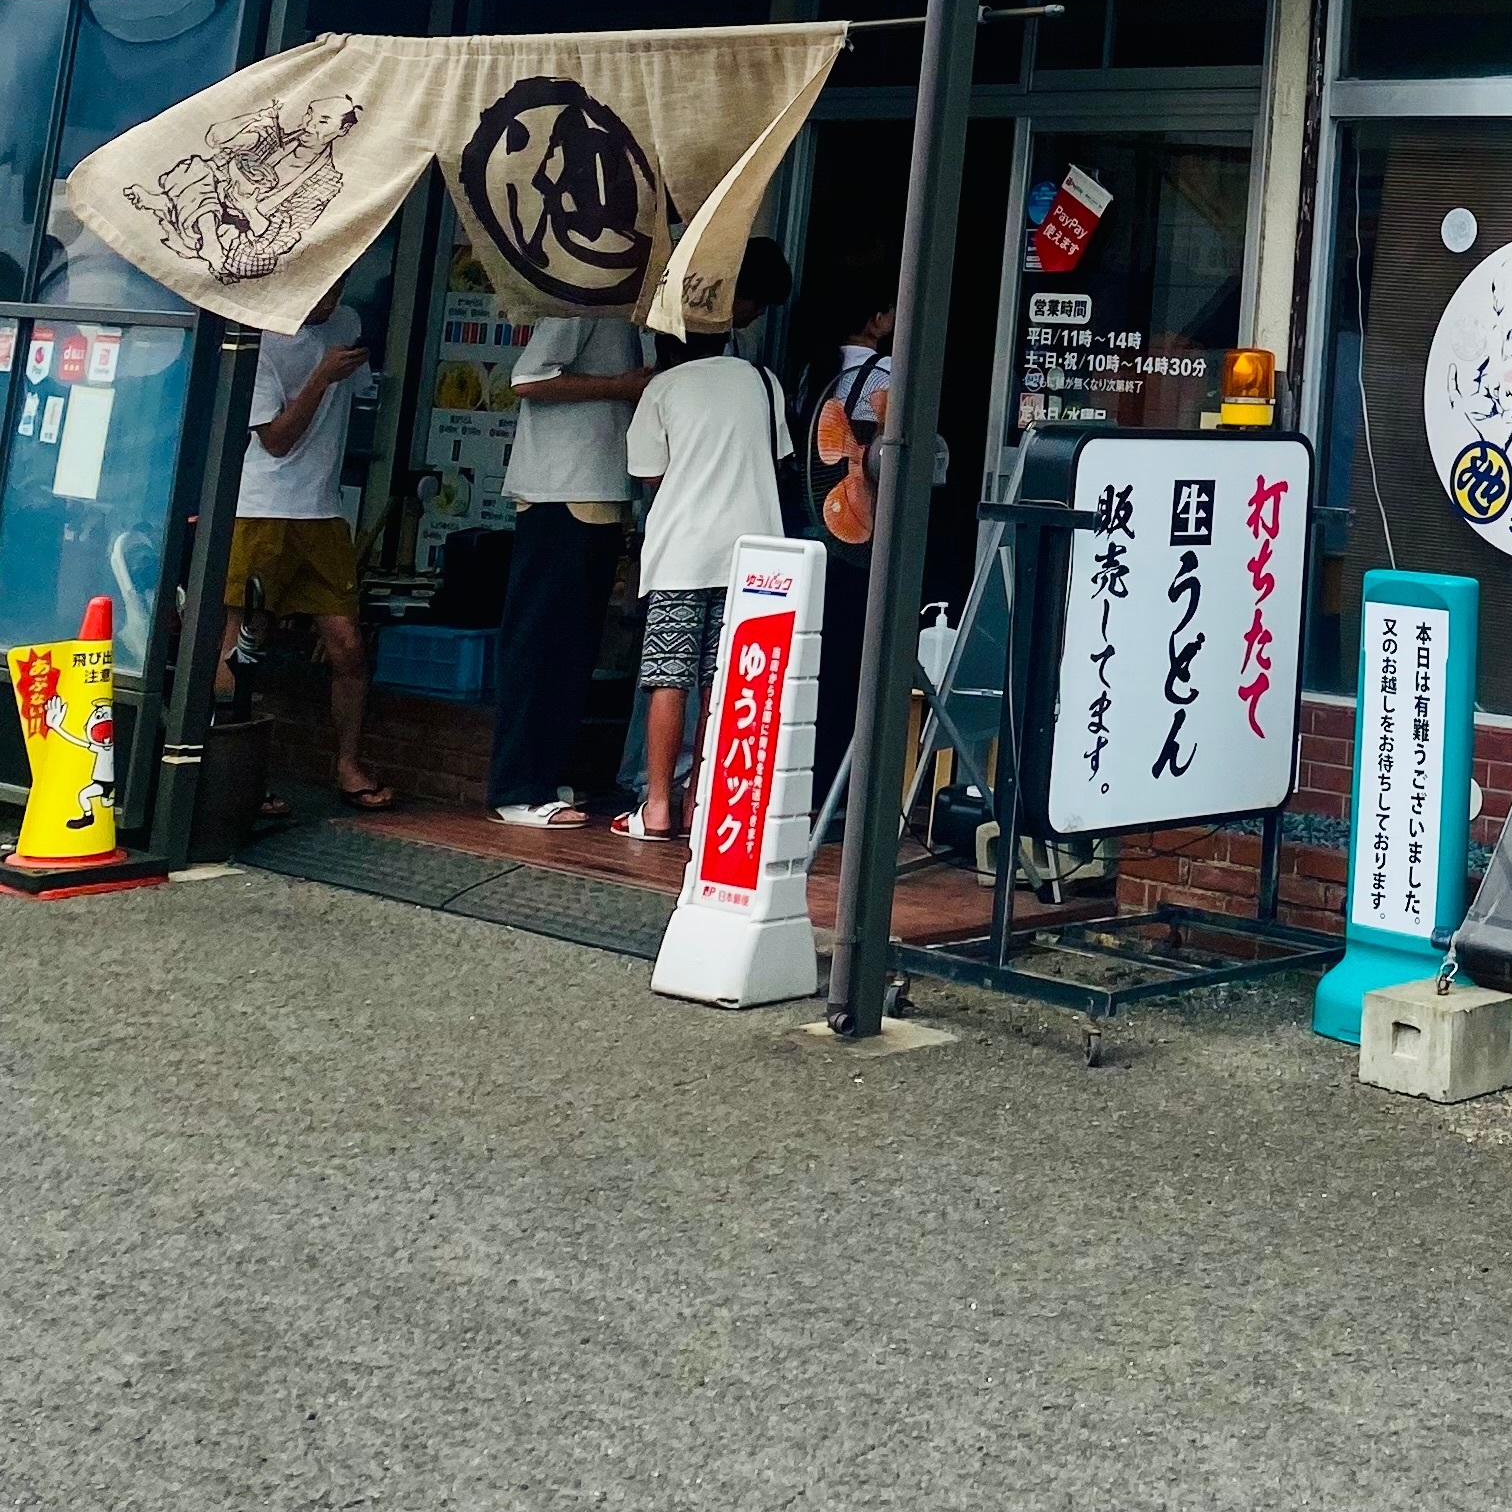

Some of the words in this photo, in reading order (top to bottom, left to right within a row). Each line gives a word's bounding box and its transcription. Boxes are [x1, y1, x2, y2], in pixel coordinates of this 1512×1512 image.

[1043, 223, 1080, 255] 使えます
[1053, 205, 1088, 239] PayPay
[1034, 299, 1088, 319] 営業時間
[745, 571, 794, 591] ゆうパック
[1151, 482, 1213, 780] 生うどん
[1237, 474, 1289, 740] 打ちたて
[716, 641, 767, 855] ゆうパック
[1404, 621, 1432, 926] 本日は有難うございました。
